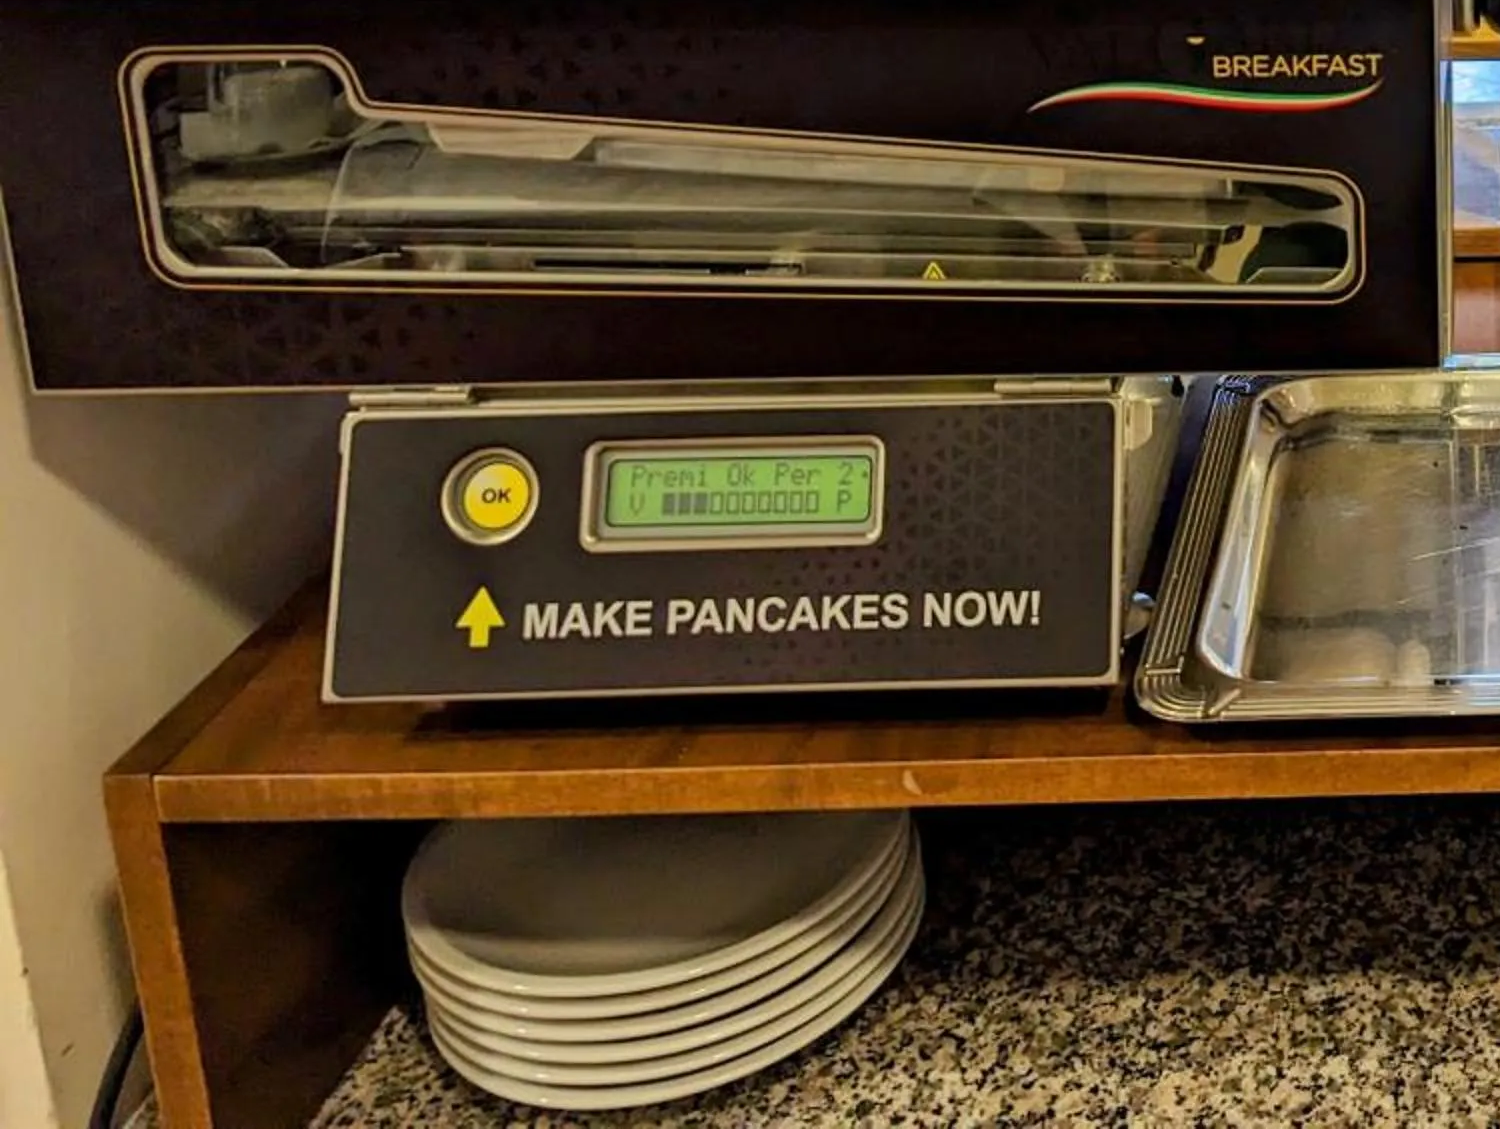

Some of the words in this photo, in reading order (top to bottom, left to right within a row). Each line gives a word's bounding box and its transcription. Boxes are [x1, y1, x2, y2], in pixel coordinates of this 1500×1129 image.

[1212, 53, 1383, 79] BREAKFAST
[773, 461, 822, 486] Per
[481, 487, 512, 505] OK
[522, 600, 653, 640] MAKE
[666, 594, 909, 635] PANCAKES
[922, 590, 1042, 628] NOW!
